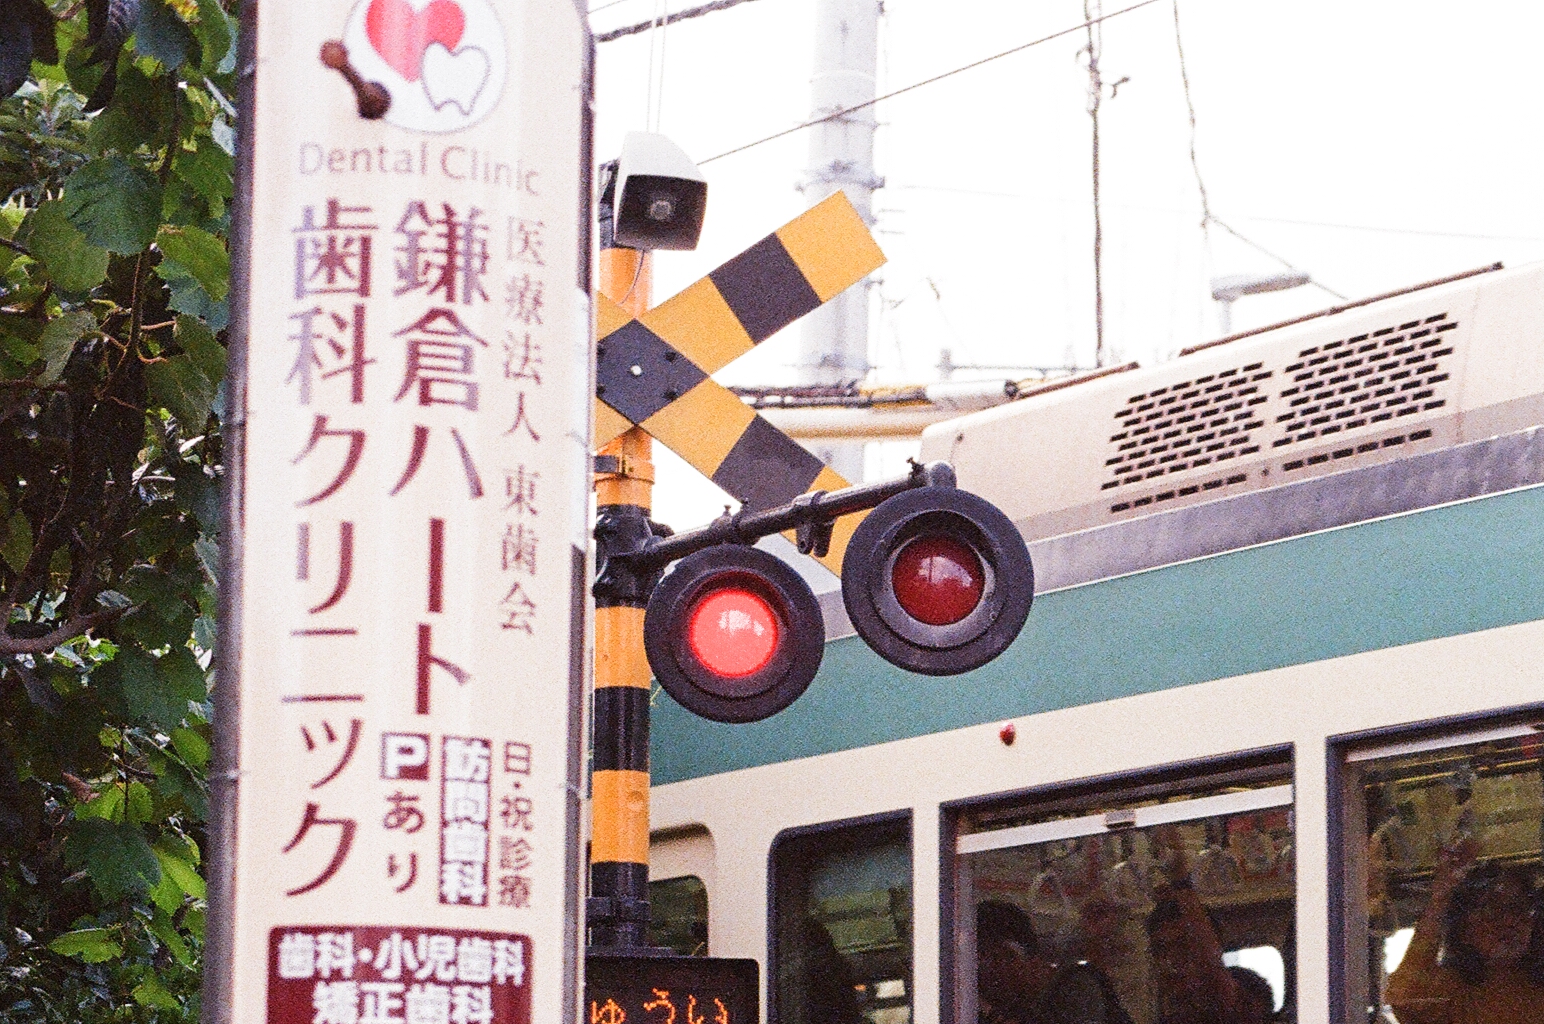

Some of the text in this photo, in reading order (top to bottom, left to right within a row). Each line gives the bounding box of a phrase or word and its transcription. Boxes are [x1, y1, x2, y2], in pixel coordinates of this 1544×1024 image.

[301, 141, 541, 197] Dental Clinic
[282, 199, 379, 896] 歯科クリニック
[390, 201, 490, 715] 鎌倉ハート
